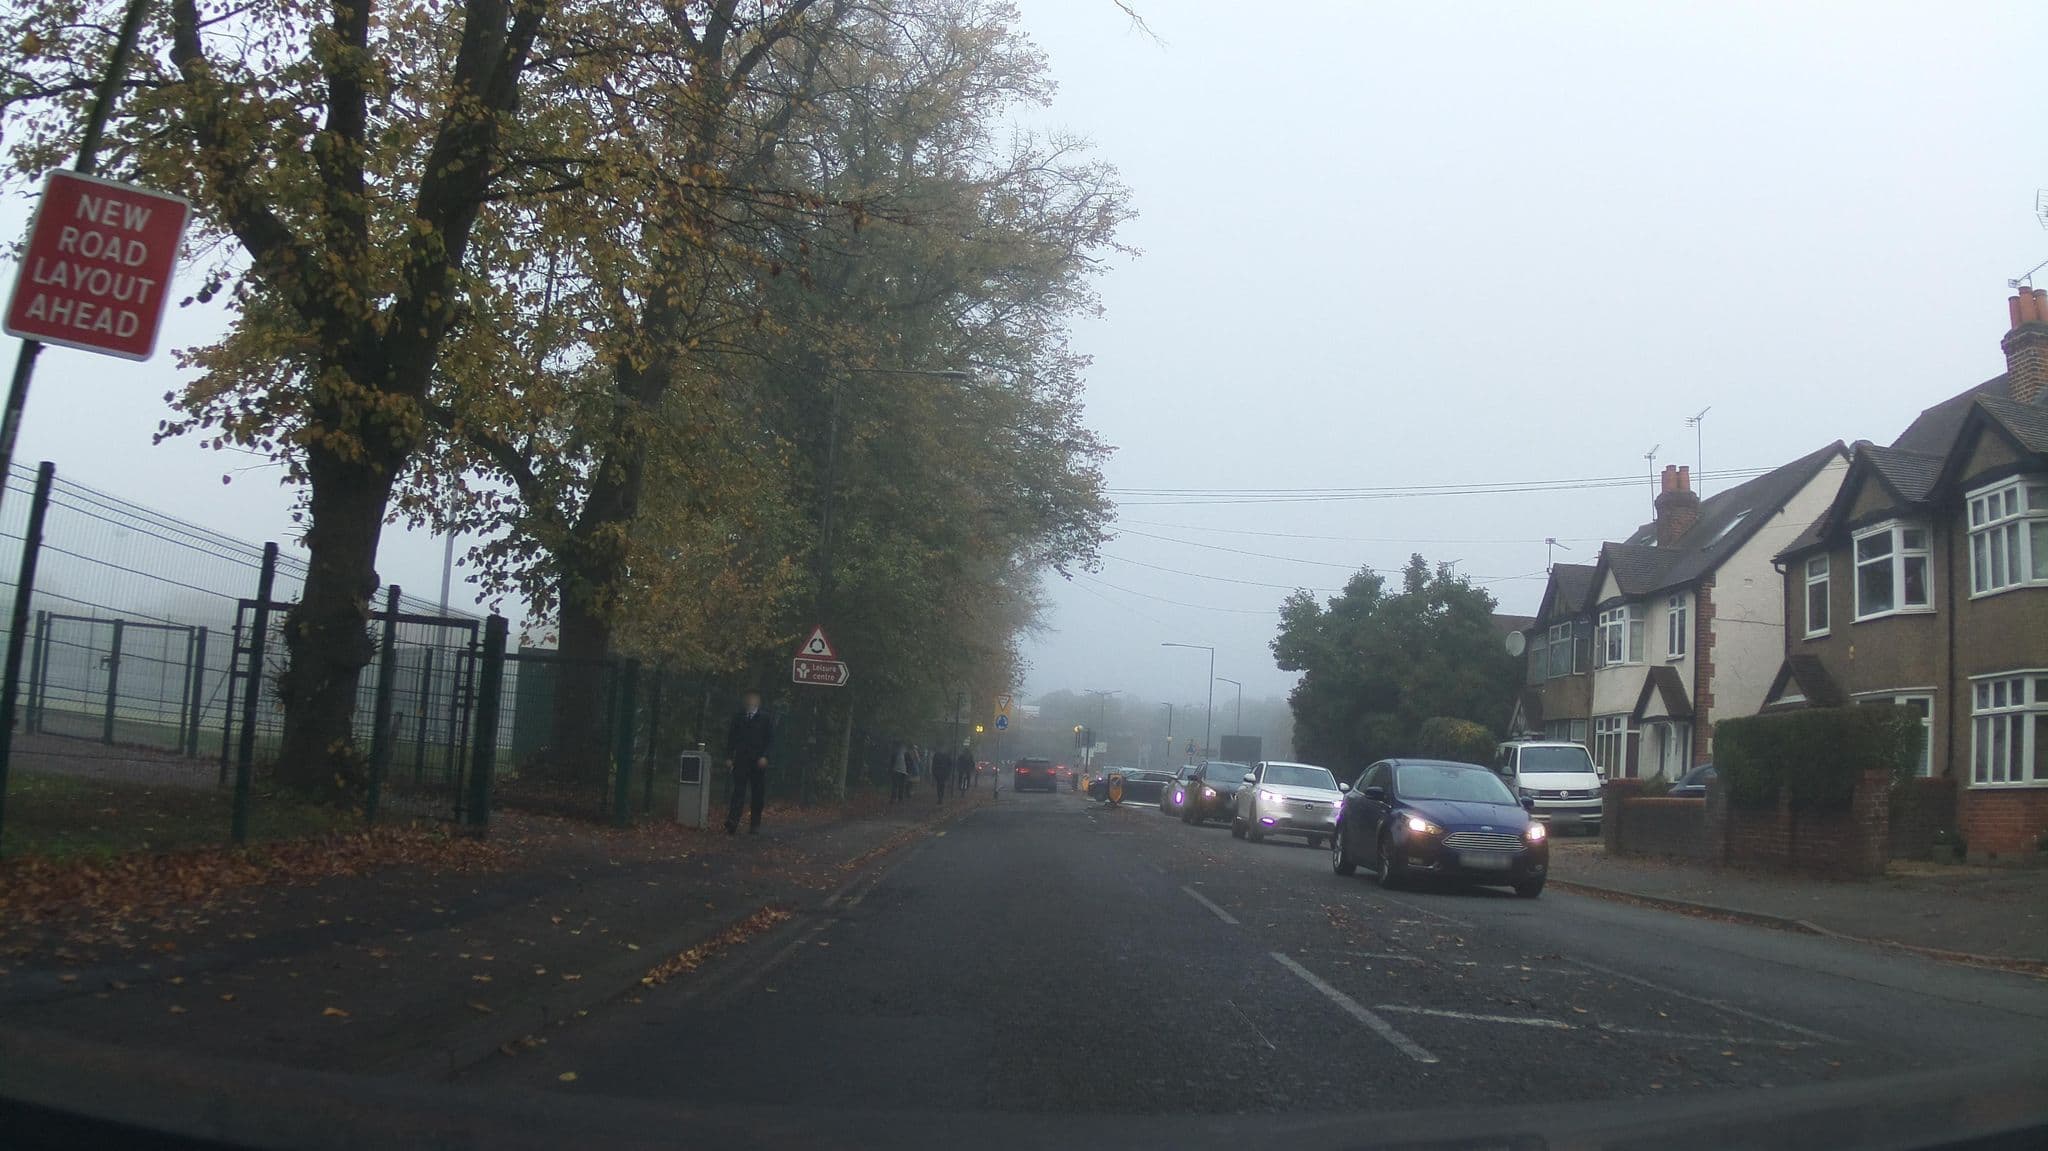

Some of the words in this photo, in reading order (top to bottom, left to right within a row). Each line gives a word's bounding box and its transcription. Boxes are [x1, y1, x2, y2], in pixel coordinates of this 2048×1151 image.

[76, 194, 152, 233] NEW
[58, 226, 147, 267] ROAD
[32, 257, 156, 305] LAYOUT
[25, 293, 140, 338] AHEAD
[812, 664, 837, 673] Leisure
[812, 672, 835, 681] centre
